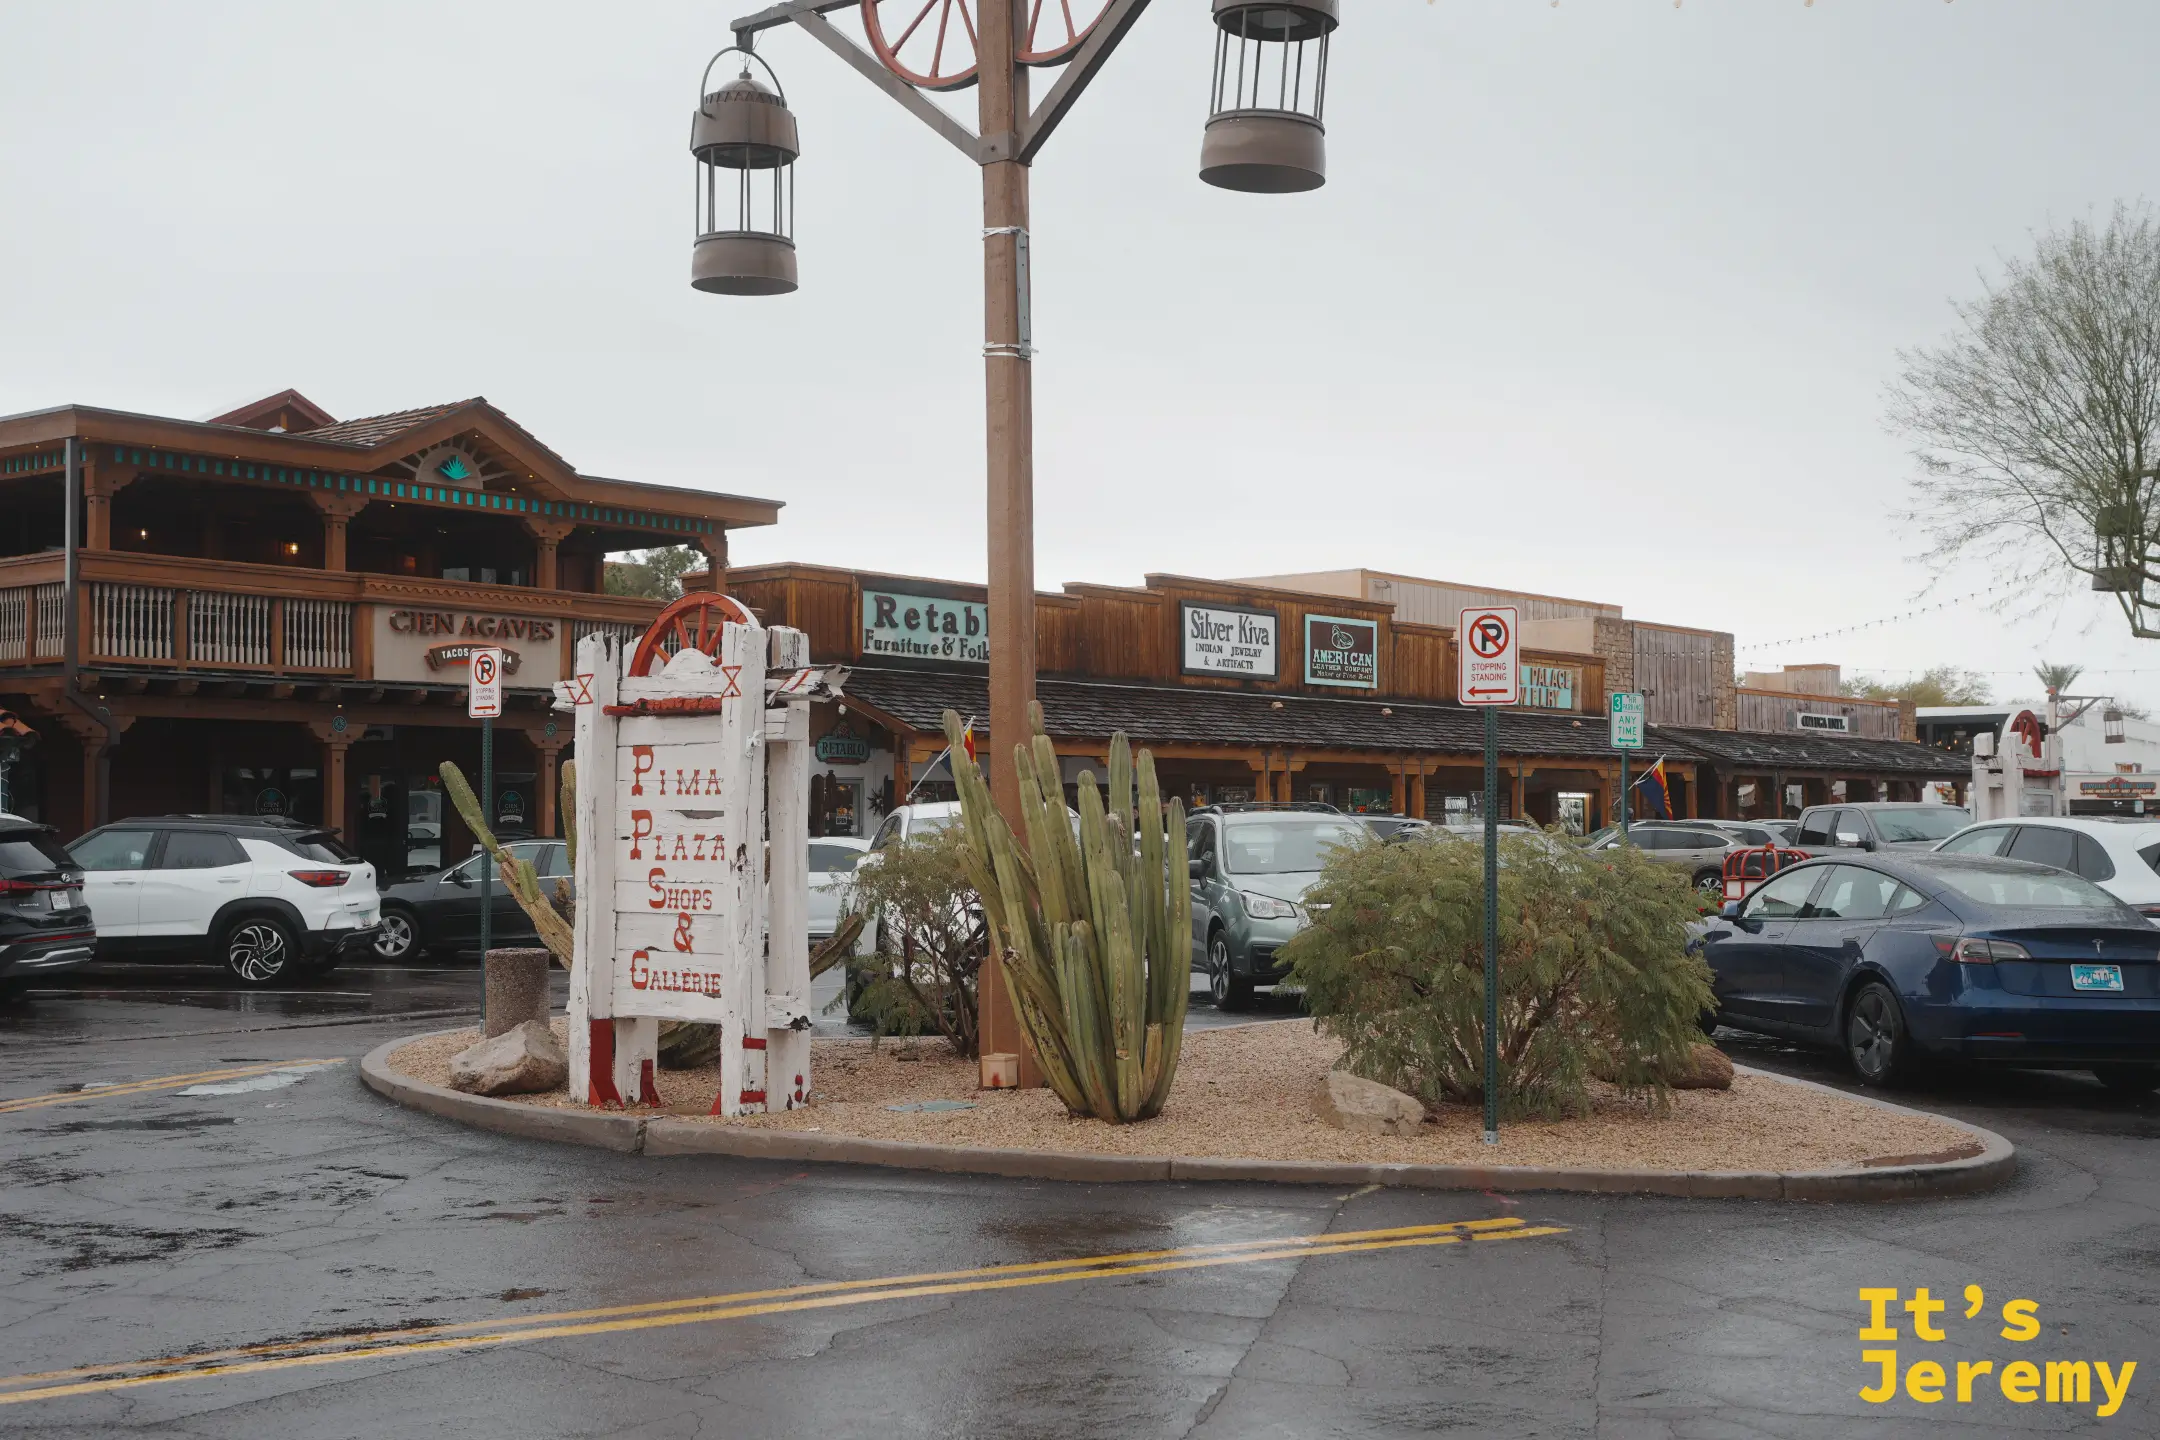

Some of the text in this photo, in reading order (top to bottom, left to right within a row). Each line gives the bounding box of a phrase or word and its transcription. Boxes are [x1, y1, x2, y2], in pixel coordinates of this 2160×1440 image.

[874, 594, 989, 637] Retabl
[389, 610, 555, 641] CIEN AGAVES
[1191, 609, 1269, 646] Silver Kiva
[863, 628, 939, 655] Furniture
[942, 636, 956, 656] &
[1195, 642, 1262, 658] INDIAN JEWELRY
[441, 647, 512, 664] TACOS LA
[1203, 656, 1254, 670] & ARTIFACTS
[1312, 648, 1372, 668] AMERICAN
[1312, 663, 1372, 674] LEATHER COMPANY
[1471, 662, 1507, 672] STOPPING
[1471, 673, 1507, 682] STANDING
[1530, 667, 1572, 689] PALACE
[475, 687, 495, 695] STOPPING
[1614, 696, 1637, 710] 3 HR
[1618, 715, 1637, 724] ANY
[1618, 726, 1637, 735] TIME
[822, 742, 865, 756] RETABLO
[631, 745, 721, 796] PIMA
[630, 810, 724, 860] PLAZA
[648, 867, 712, 910] SHOPS
[673, 912, 694, 955] &
[630, 950, 721, 994] GALLERIE
